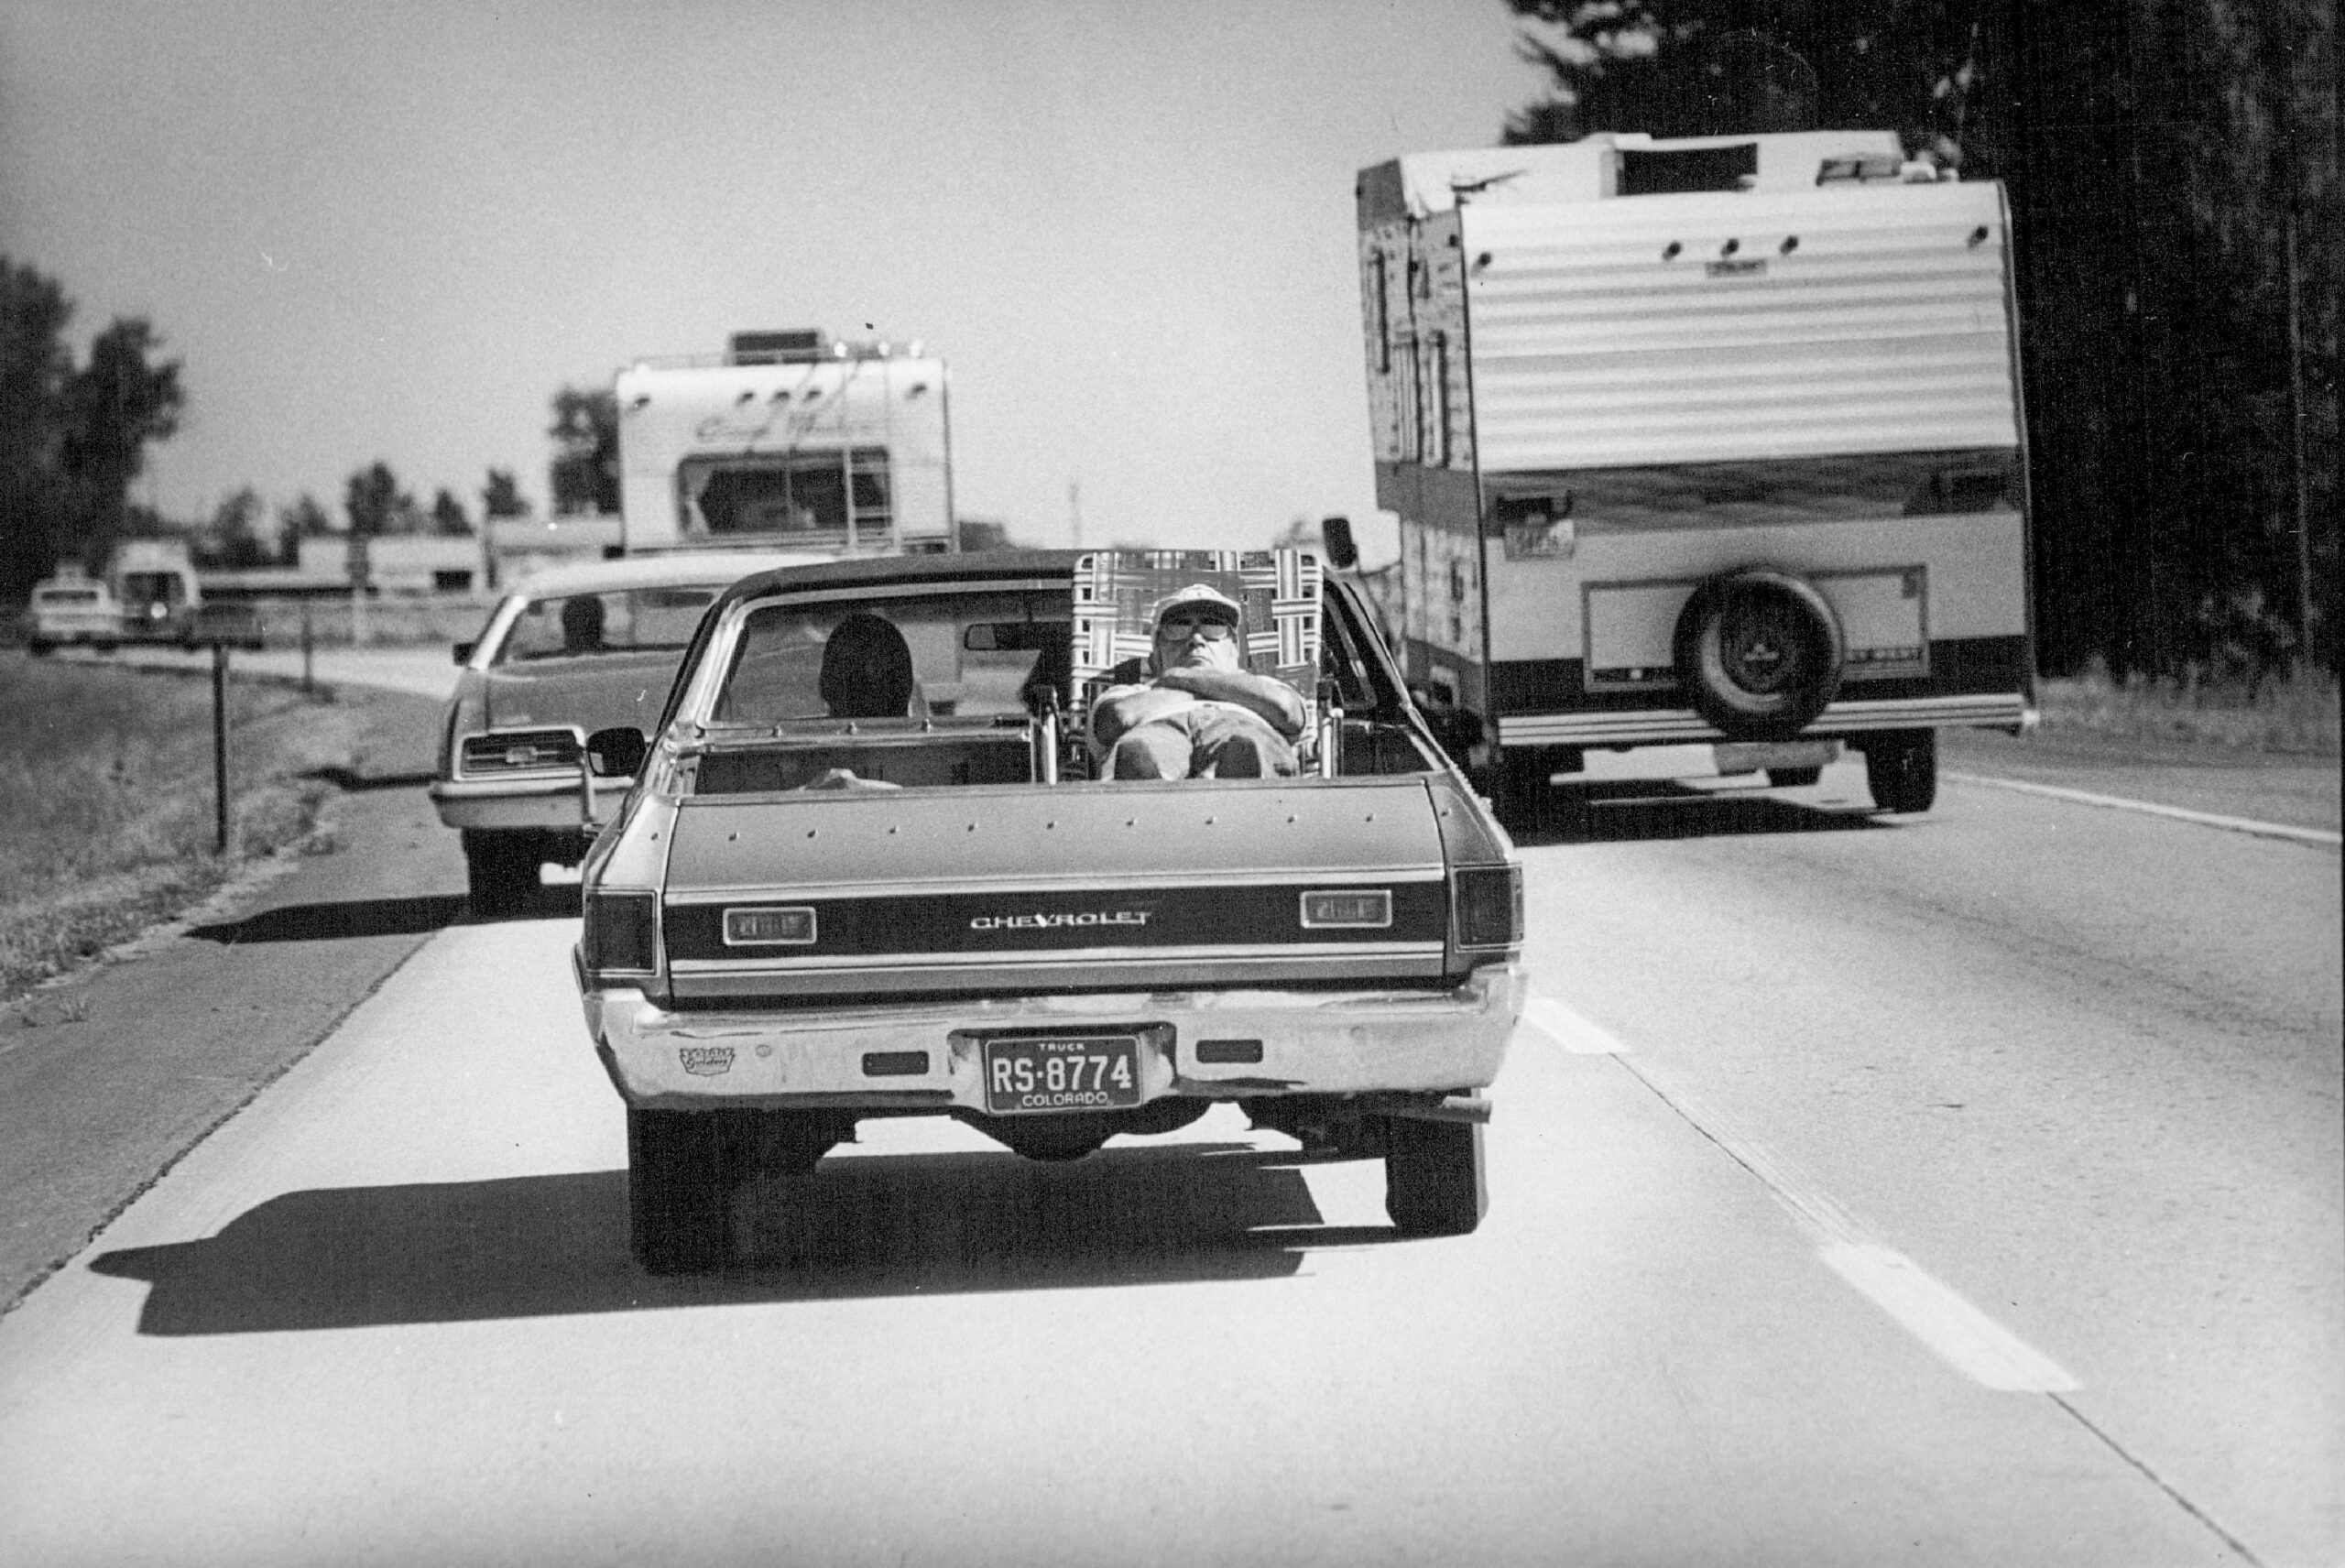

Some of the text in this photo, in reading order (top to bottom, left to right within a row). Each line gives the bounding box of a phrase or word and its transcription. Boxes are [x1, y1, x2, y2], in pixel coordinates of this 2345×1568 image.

[970, 911, 1151, 929] CHEVROLET
[1039, 1042, 1085, 1052] TRUCK
[1021, 1091, 1109, 1107] COLORADO
